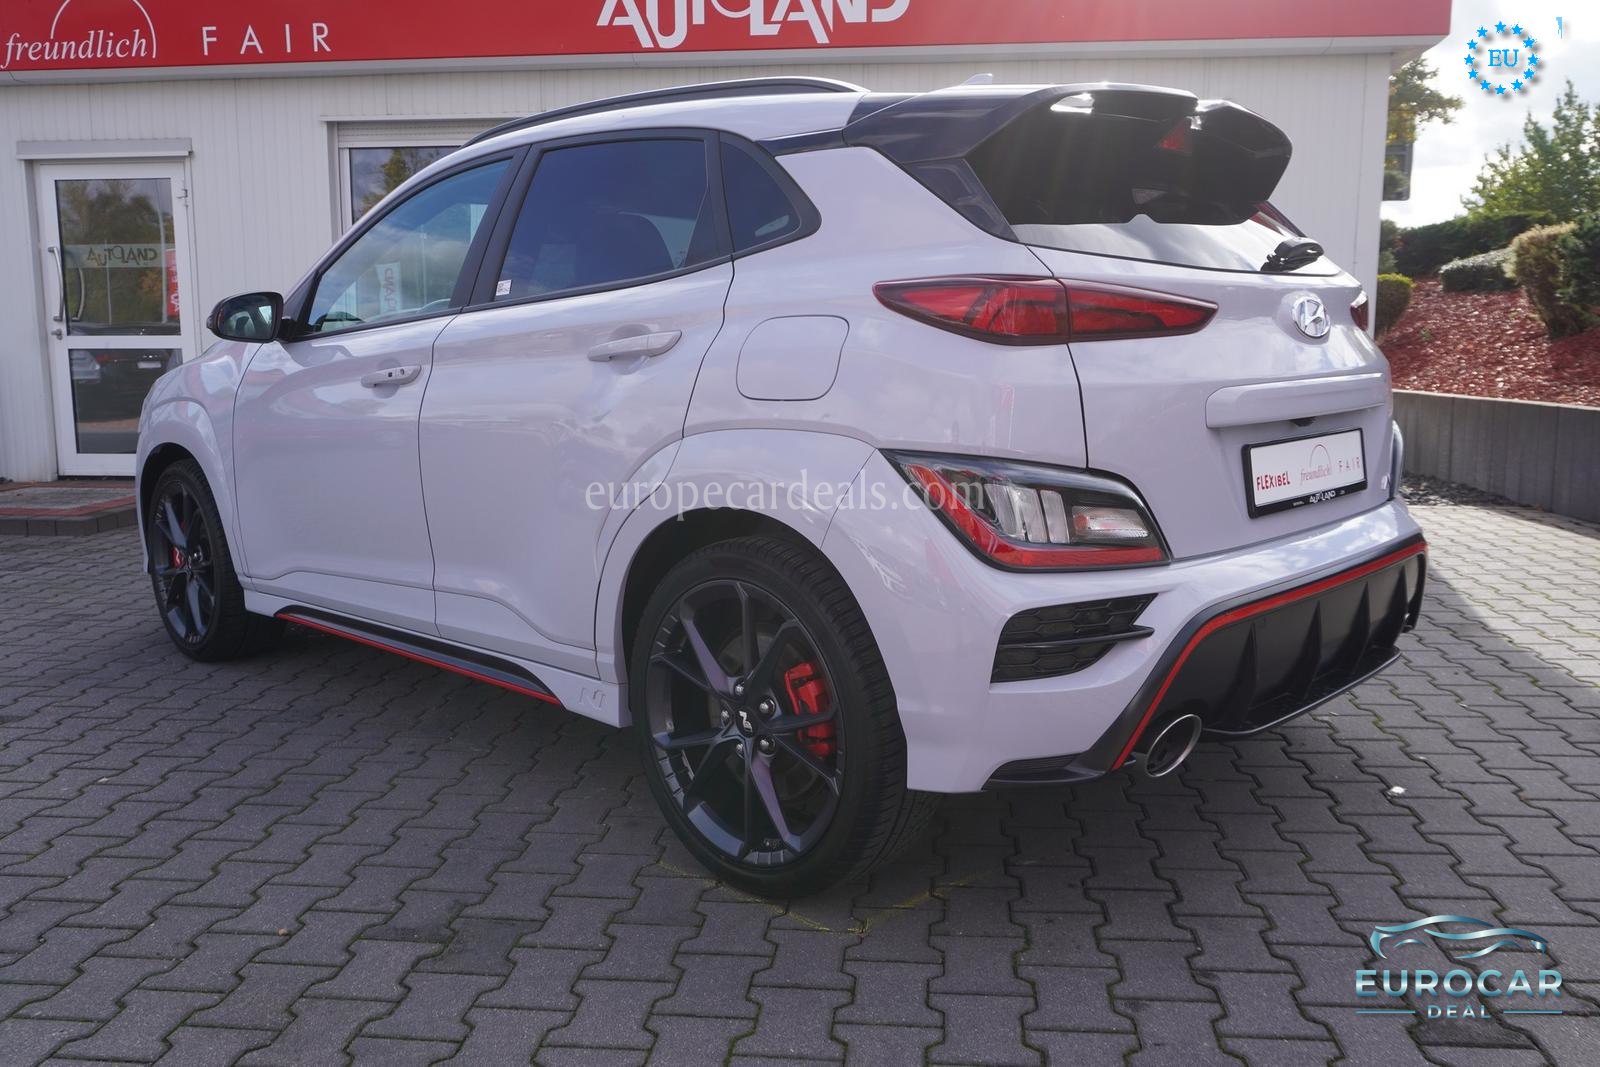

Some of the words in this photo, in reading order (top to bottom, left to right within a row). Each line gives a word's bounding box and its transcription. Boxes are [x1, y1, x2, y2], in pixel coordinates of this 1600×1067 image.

[1, 29, 148, 69] freundlich
[202, 22, 332, 56] FAIR
[1256, 471, 1291, 491] FLEXIBEL
